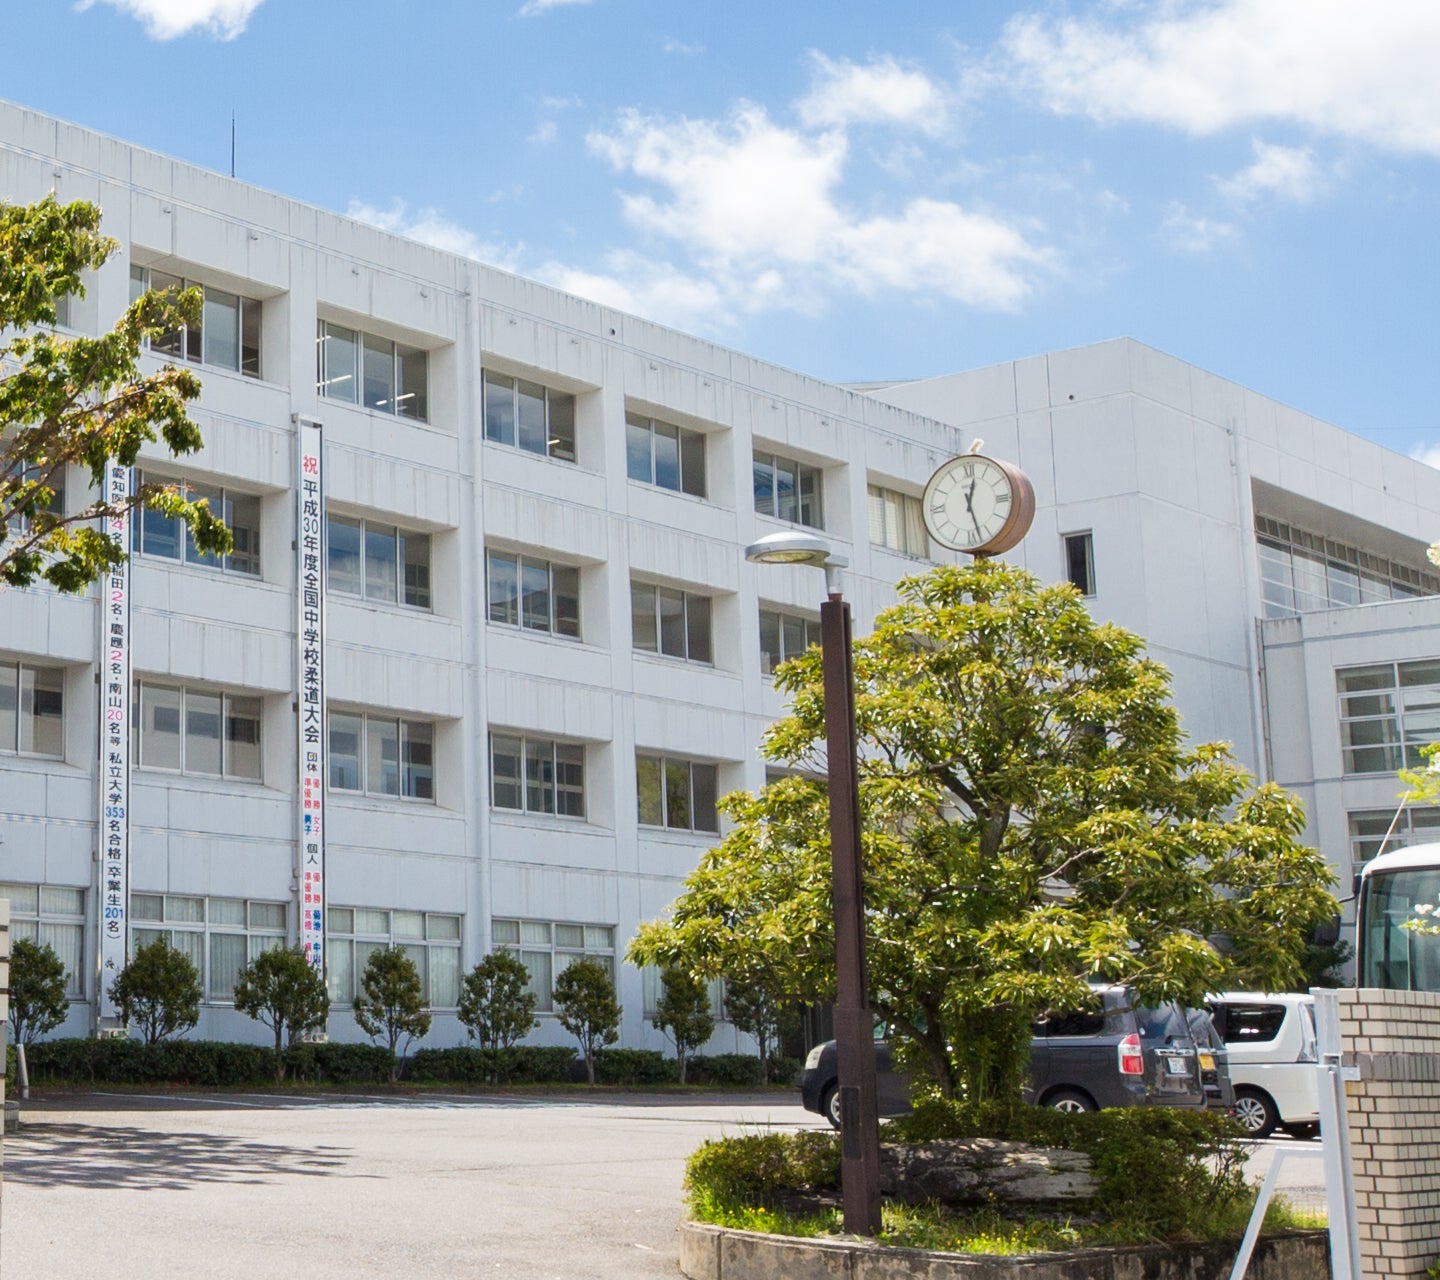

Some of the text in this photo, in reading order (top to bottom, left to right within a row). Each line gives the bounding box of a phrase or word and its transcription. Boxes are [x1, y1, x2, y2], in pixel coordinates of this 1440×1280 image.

[303, 455, 319, 743] 祝 平成30年度全国中学校柔道大会
[306, 751, 318, 772] 団体
[307, 843, 318, 865] 個人
